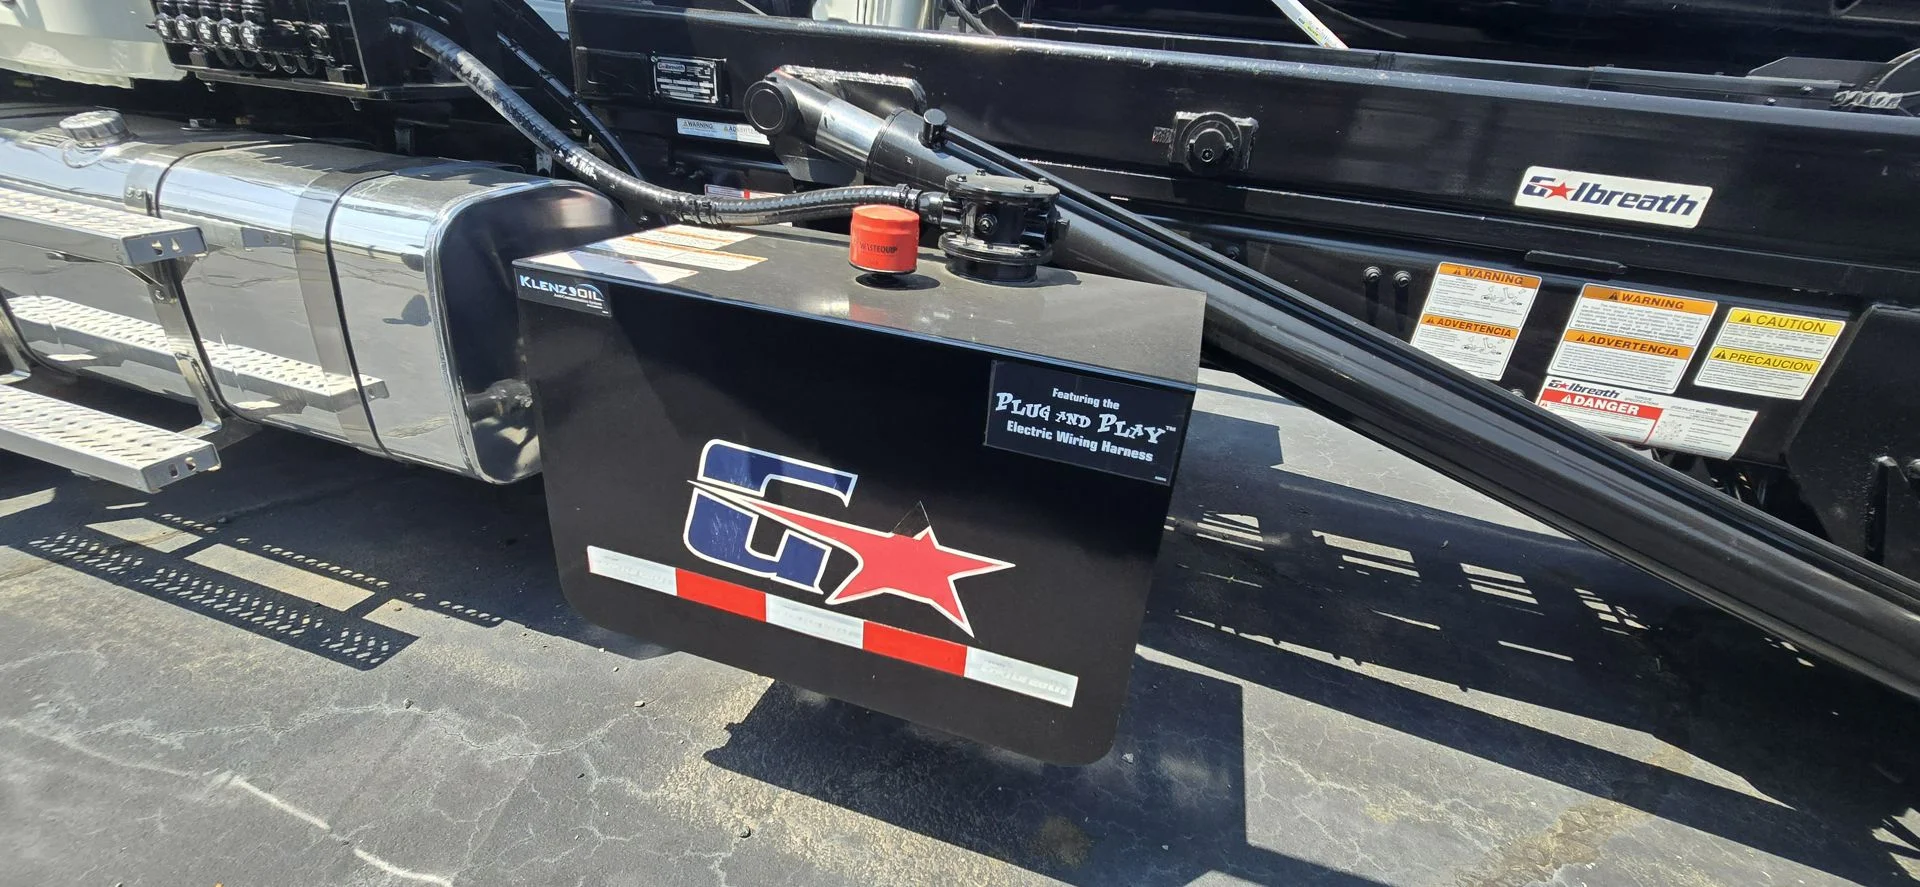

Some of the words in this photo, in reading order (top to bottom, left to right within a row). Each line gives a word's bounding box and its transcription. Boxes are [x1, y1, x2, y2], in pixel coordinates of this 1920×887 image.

[1465, 268, 1524, 285] WARNING
[1621, 292, 1685, 310] WARNING
[1437, 319, 1511, 337] ADVERTENCIA
[1756, 315, 1826, 333] CAUTION
[1588, 336, 1679, 357] ADVERTENCIA
[1052, 387, 1100, 408] Featuring
[1102, 398, 1120, 410] the
[1573, 395, 1640, 415] DANGER
[995, 392, 1050, 421] PLUG
[1055, 411, 1091, 429] AND
[1006, 420, 1053, 440] Electric
[1056, 430, 1098, 452] Wiring
[1101, 440, 1153, 462] Harness
